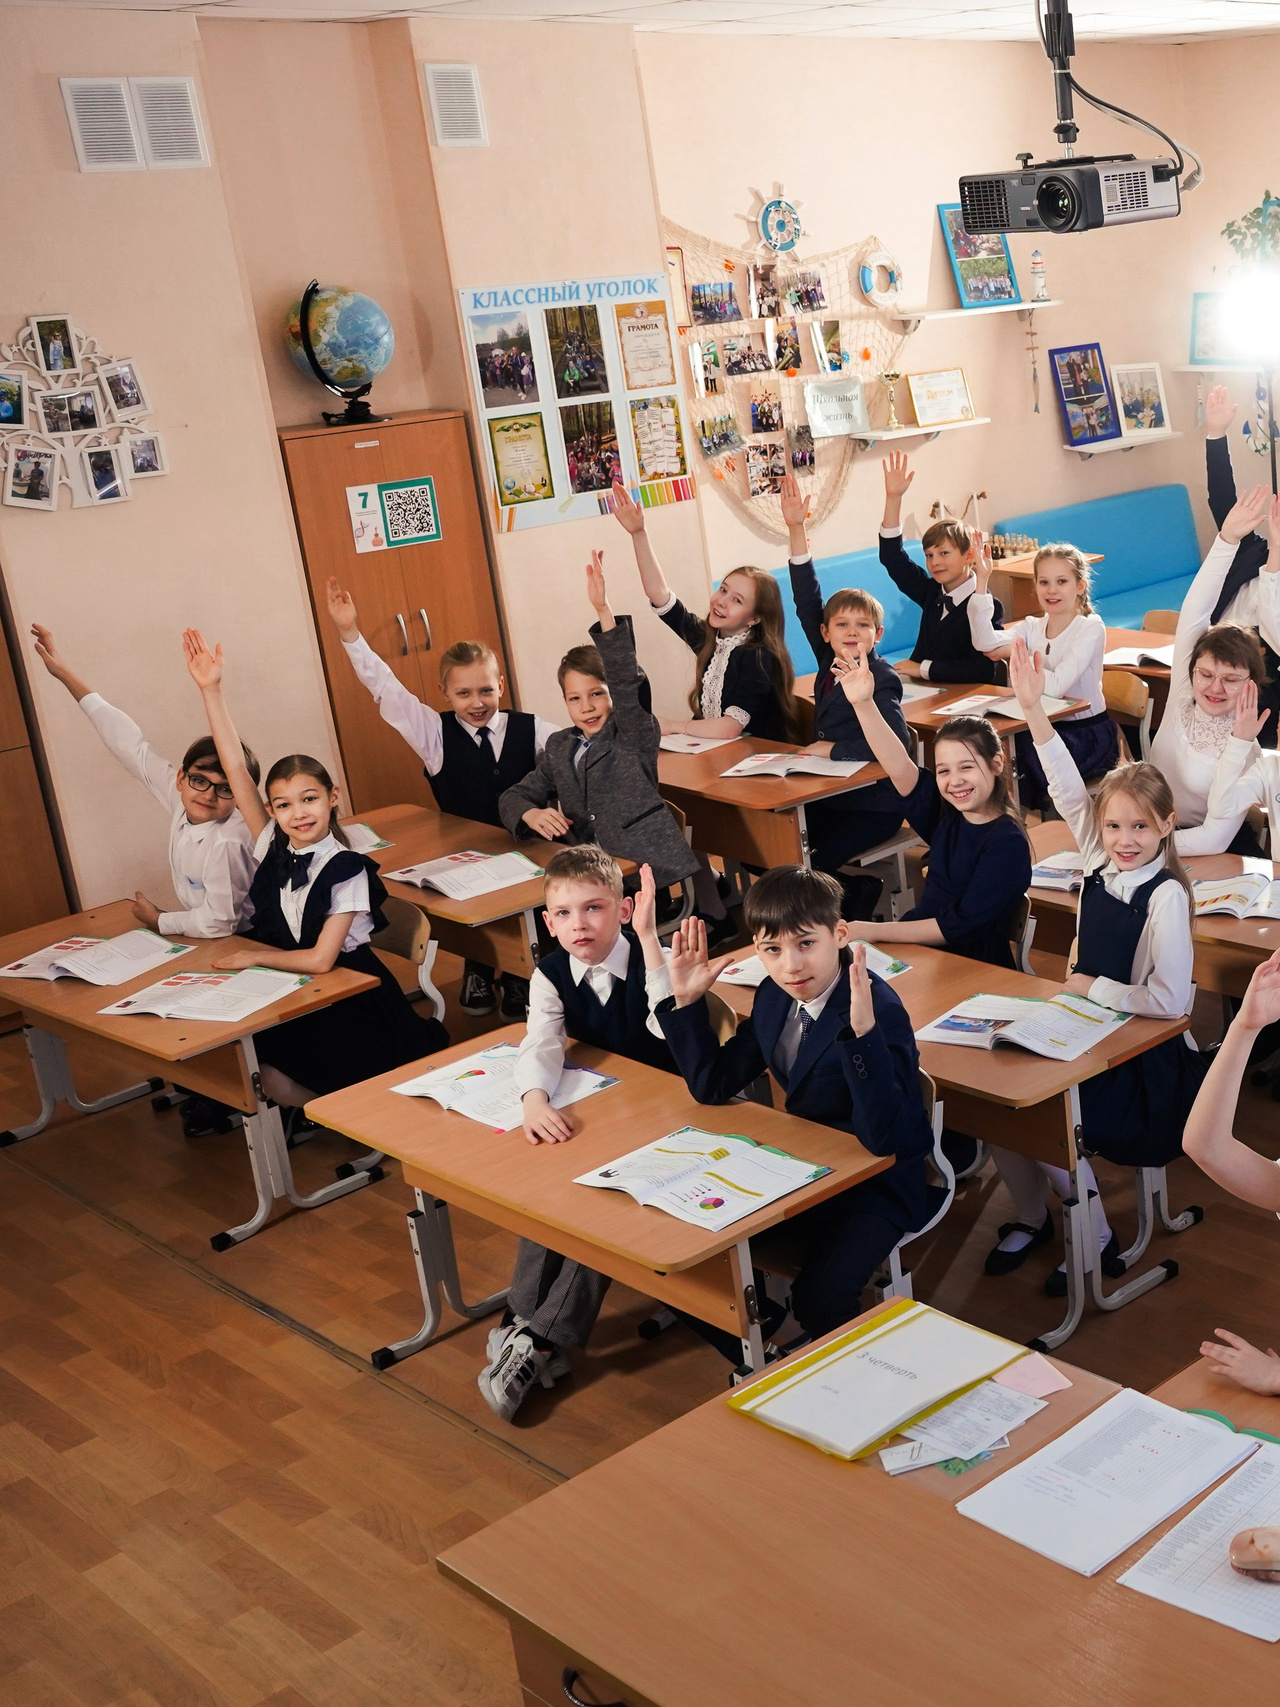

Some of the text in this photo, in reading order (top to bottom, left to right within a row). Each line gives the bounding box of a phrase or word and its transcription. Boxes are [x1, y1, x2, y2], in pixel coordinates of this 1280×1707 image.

[473, 278, 658, 309] КЛАССНЫЙ УГОЛОК
[627, 323, 659, 332] ГРАМОТА
[812, 393, 859, 405] Школьная
[823, 412, 853, 422] жизнь
[357, 491, 369, 509] 7
[856, 1351, 918, 1381] 3 четверть
